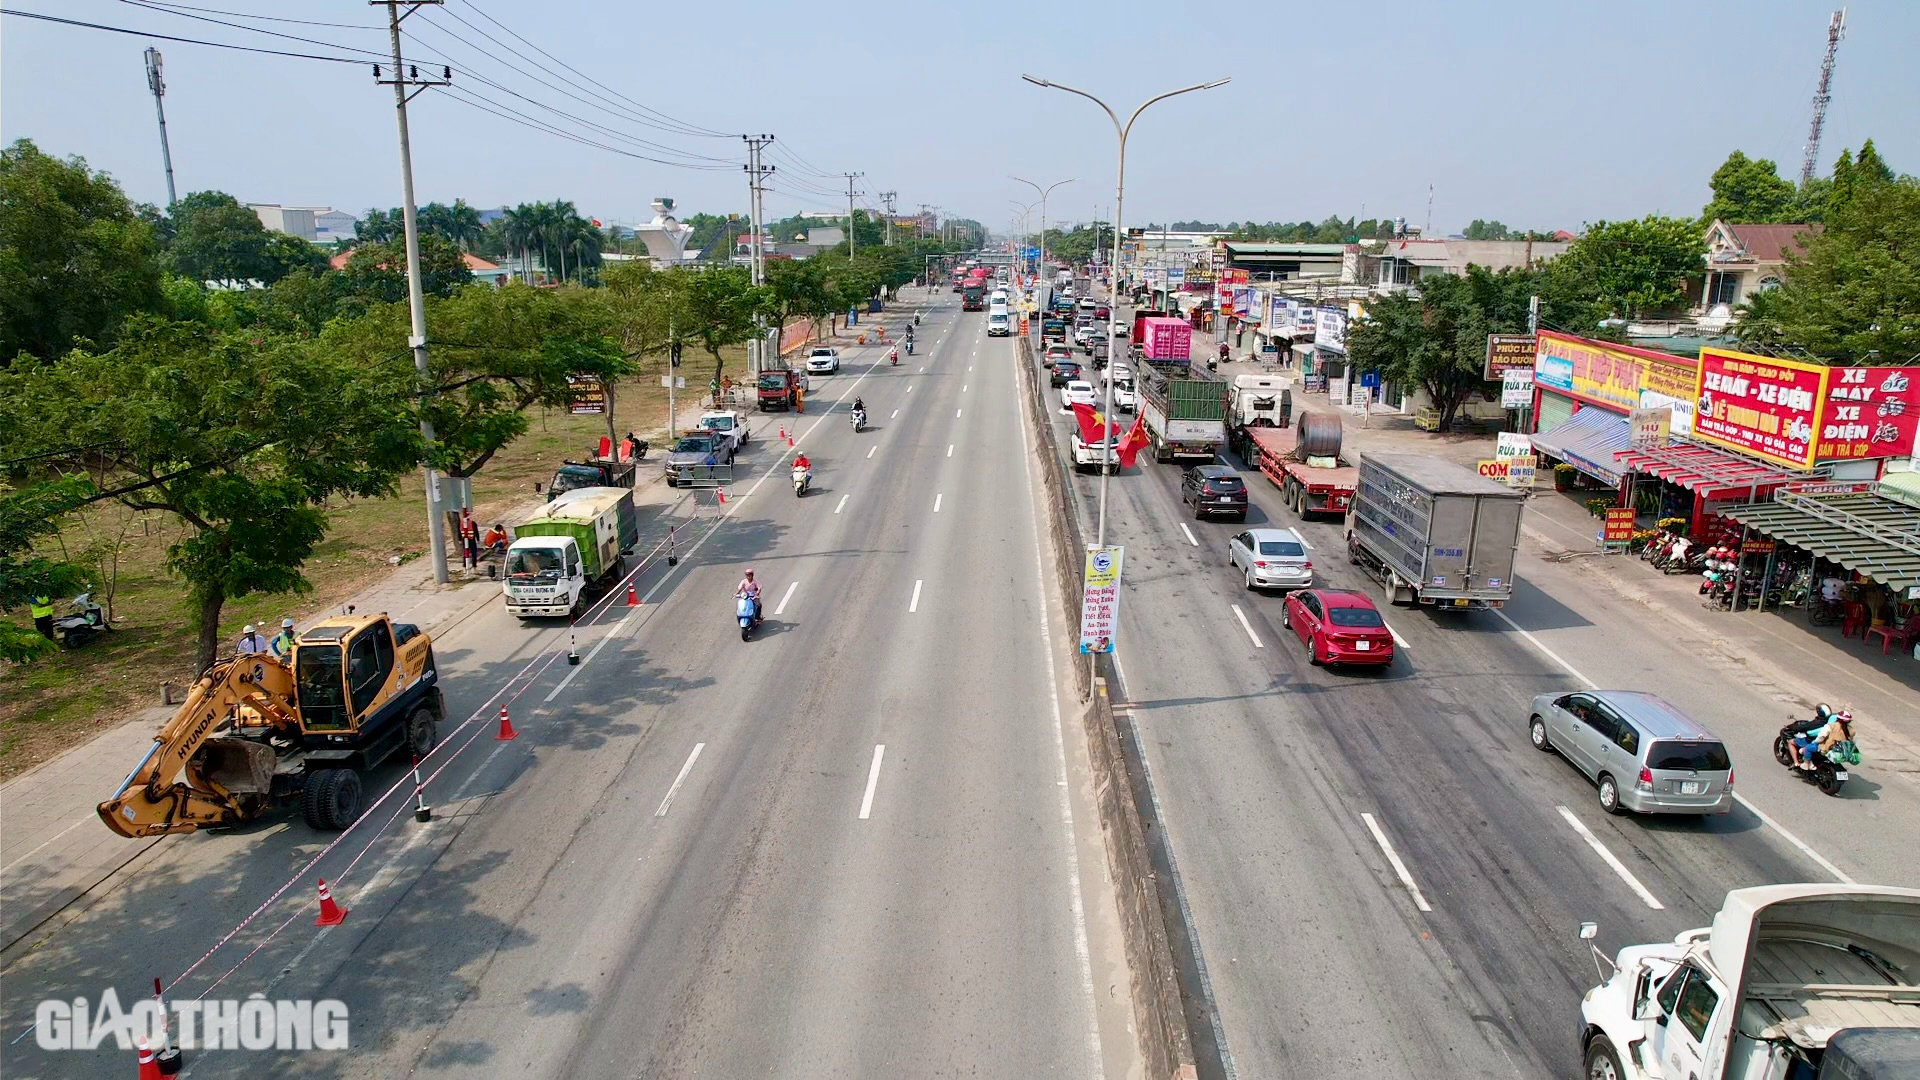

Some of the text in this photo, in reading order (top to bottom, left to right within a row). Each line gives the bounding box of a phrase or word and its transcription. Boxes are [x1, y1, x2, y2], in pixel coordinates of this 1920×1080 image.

[1840, 369, 1867, 383] XE
[1522, 382, 1532, 390] XE
[1704, 371, 1721, 390] XE
[1720, 375, 1750, 397] MÁY
[1757, 383, 1778, 404] XE
[1778, 386, 1813, 413] ĐIỆN
[1830, 385, 1875, 402] MÁY
[1835, 406, 1861, 420] XE
[1824, 422, 1869, 442] ĐIỆN
[1754, 434, 1764, 443] XE
[1789, 443, 1803, 454] CAO
[1817, 442, 1833, 456] BÁN
[1836, 442, 1850, 456] TRẢ
[1853, 442, 1868, 456] GÓP
[1480, 462, 1508, 476] CƠM
[178, 708, 216, 759] HYUNDAI
